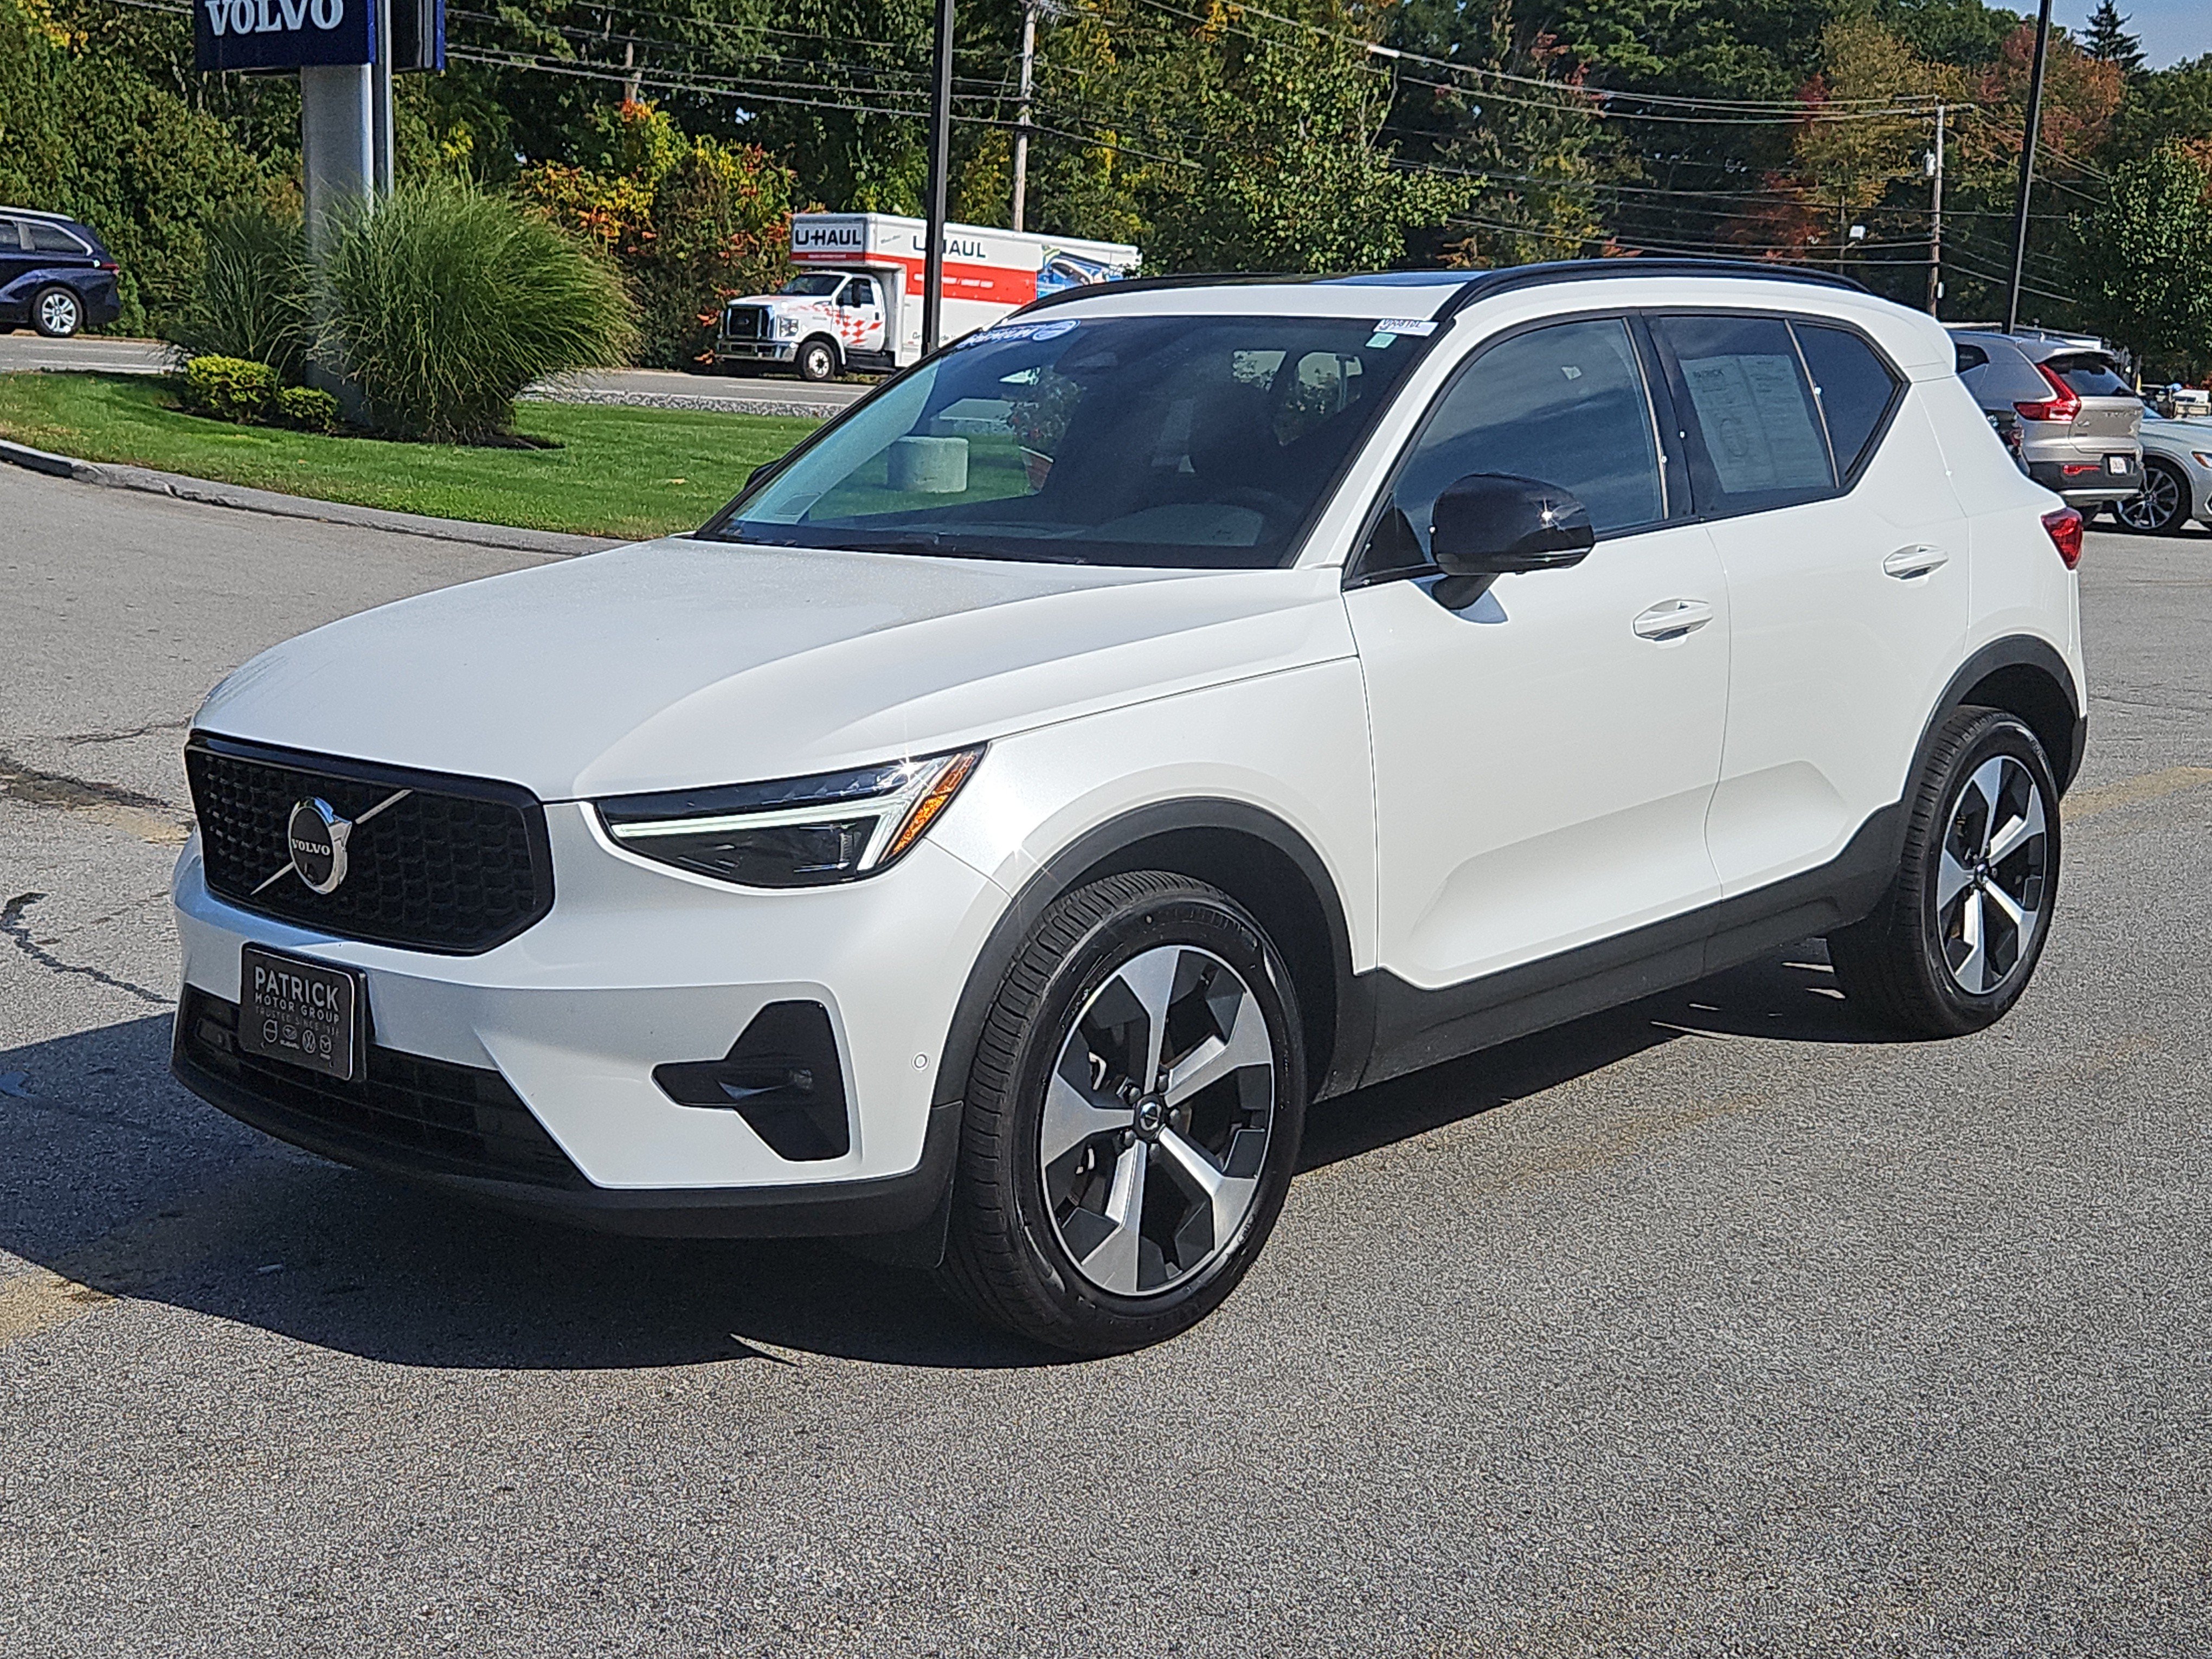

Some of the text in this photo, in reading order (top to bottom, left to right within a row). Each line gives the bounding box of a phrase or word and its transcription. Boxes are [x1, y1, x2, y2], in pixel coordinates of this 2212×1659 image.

[205, 0, 344, 36] VOLVO
[795, 229, 861, 246] U-HAUL
[913, 235, 986, 258] UAUL
[292, 838, 331, 856] VOLVO
[255, 966, 339, 1012] PATRICK
[255, 992, 339, 1025] MOTOR GROUP
